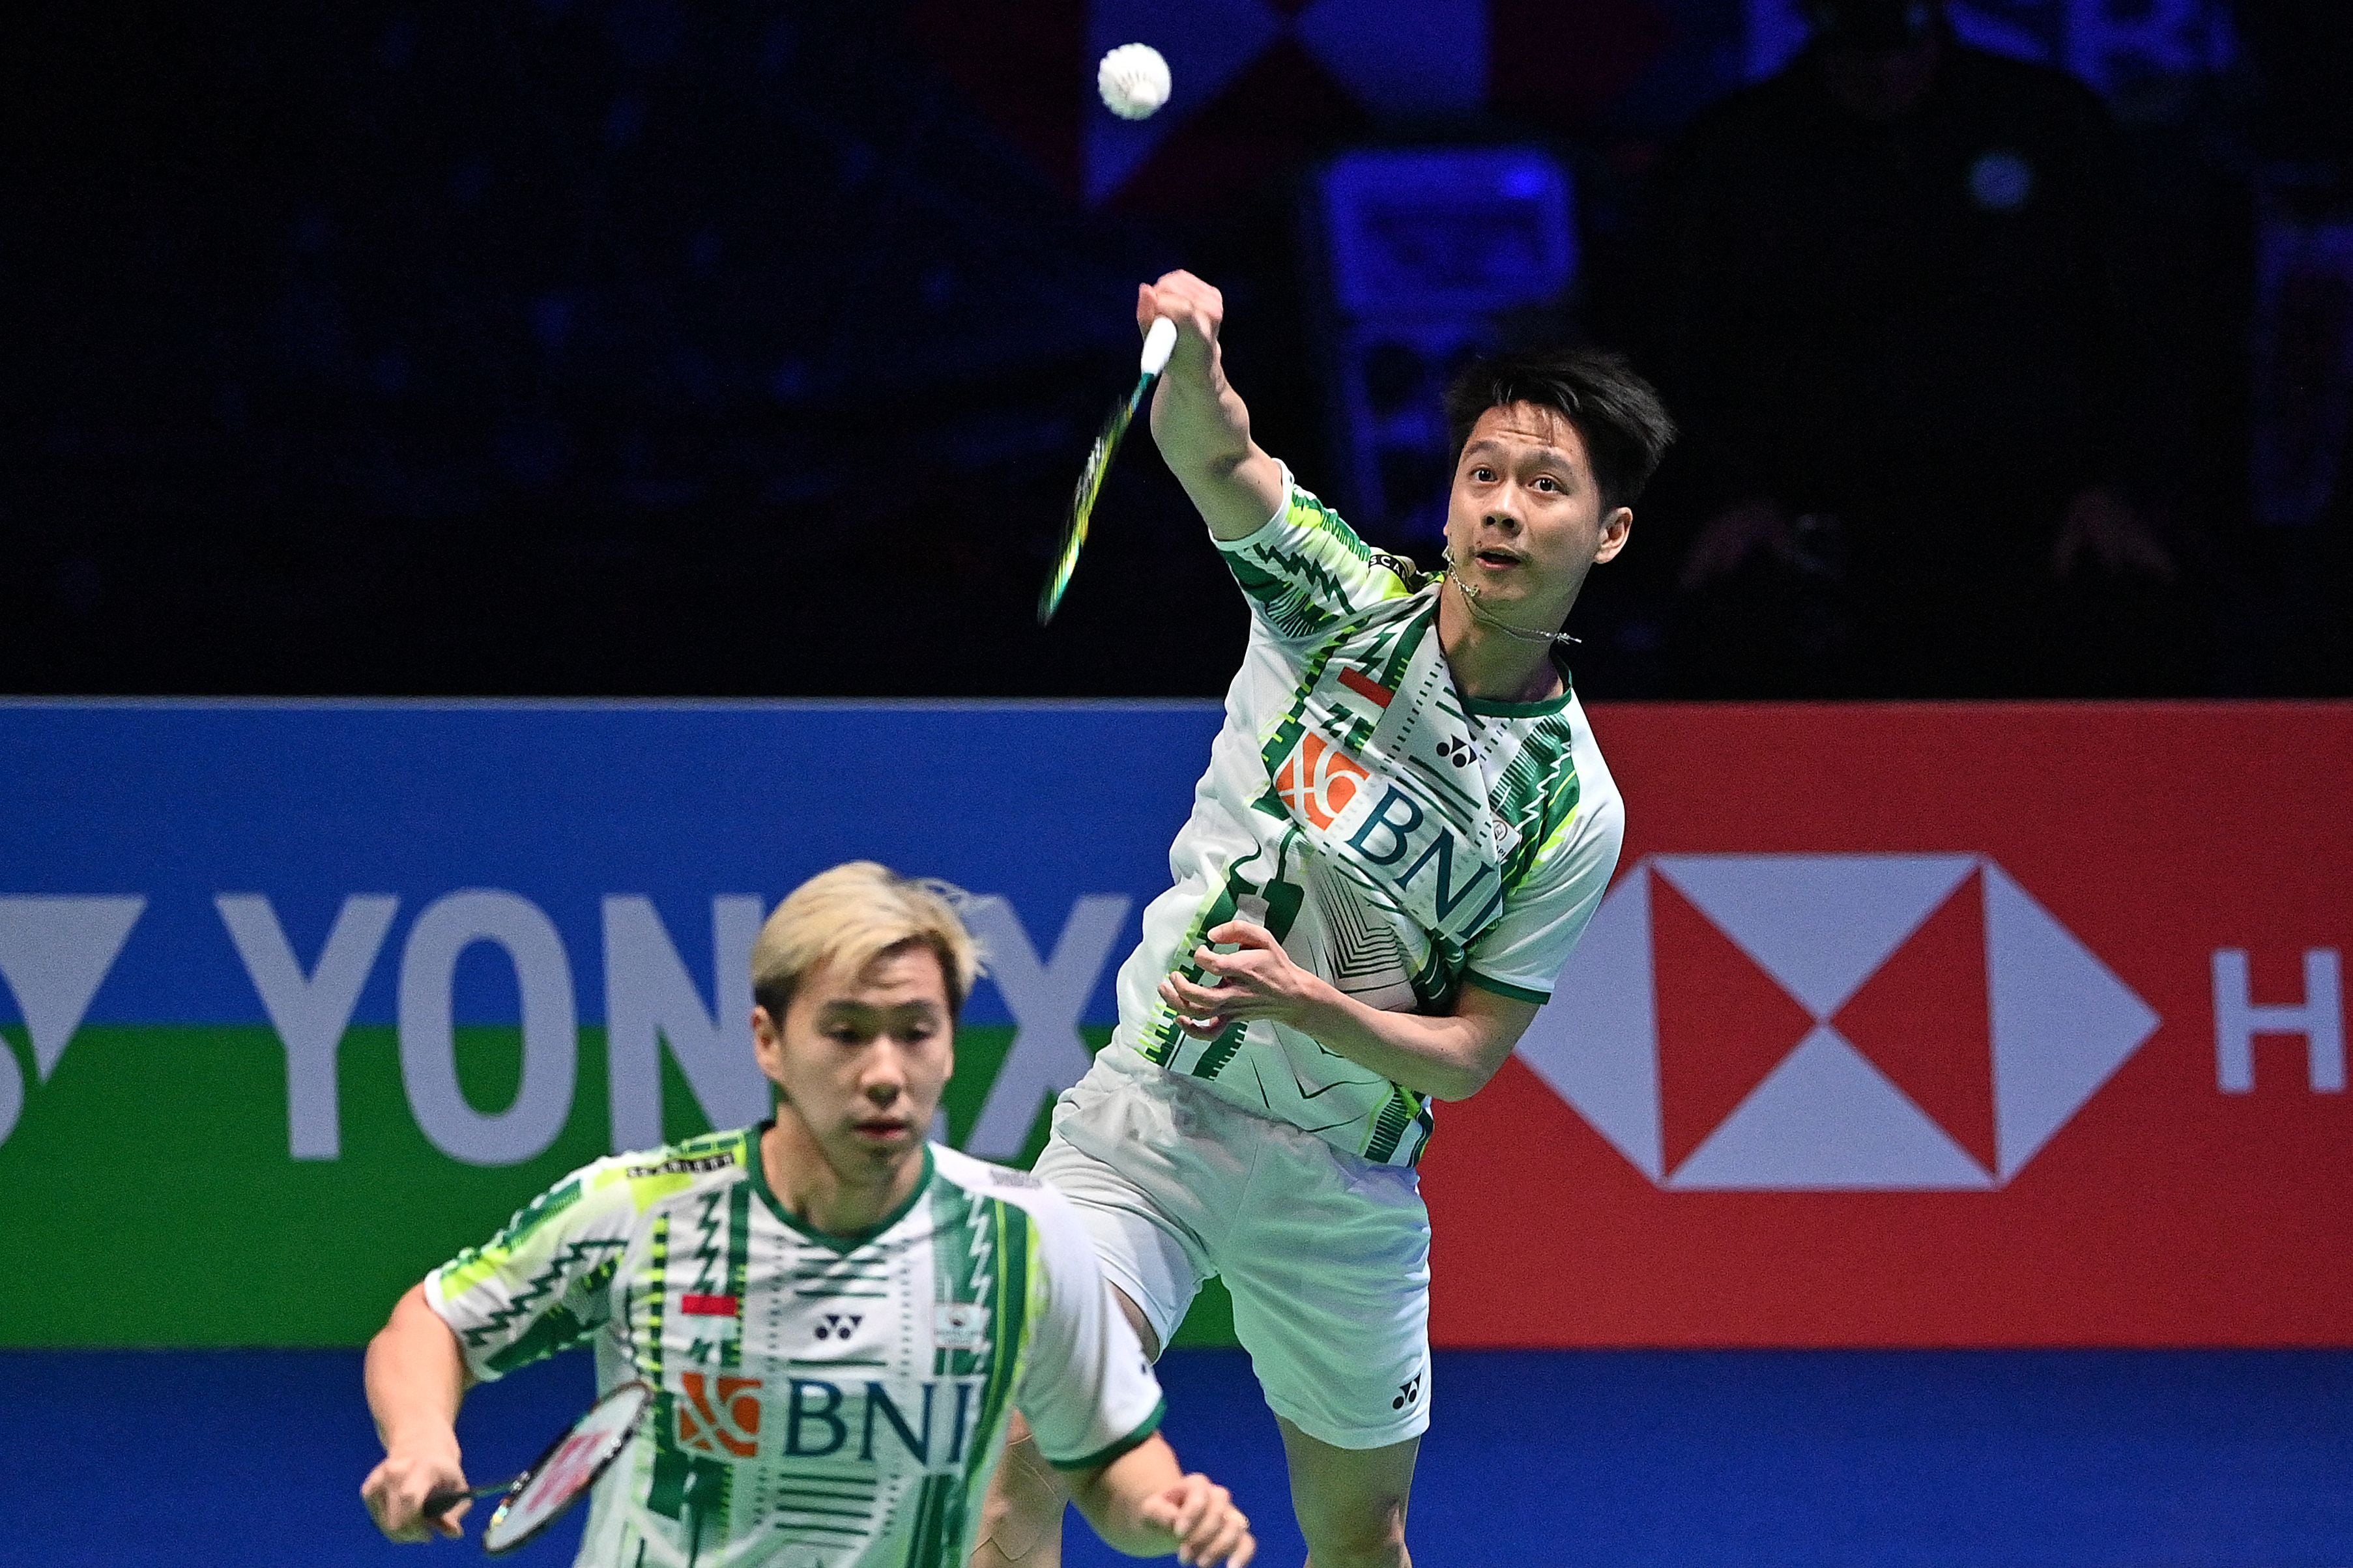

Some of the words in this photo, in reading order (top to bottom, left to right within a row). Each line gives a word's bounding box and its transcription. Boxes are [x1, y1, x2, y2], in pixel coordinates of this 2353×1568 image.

[1344, 783, 1501, 939] BNI
[214, 887, 1132, 1167] YONX
[783, 1377, 974, 1466] BNI
